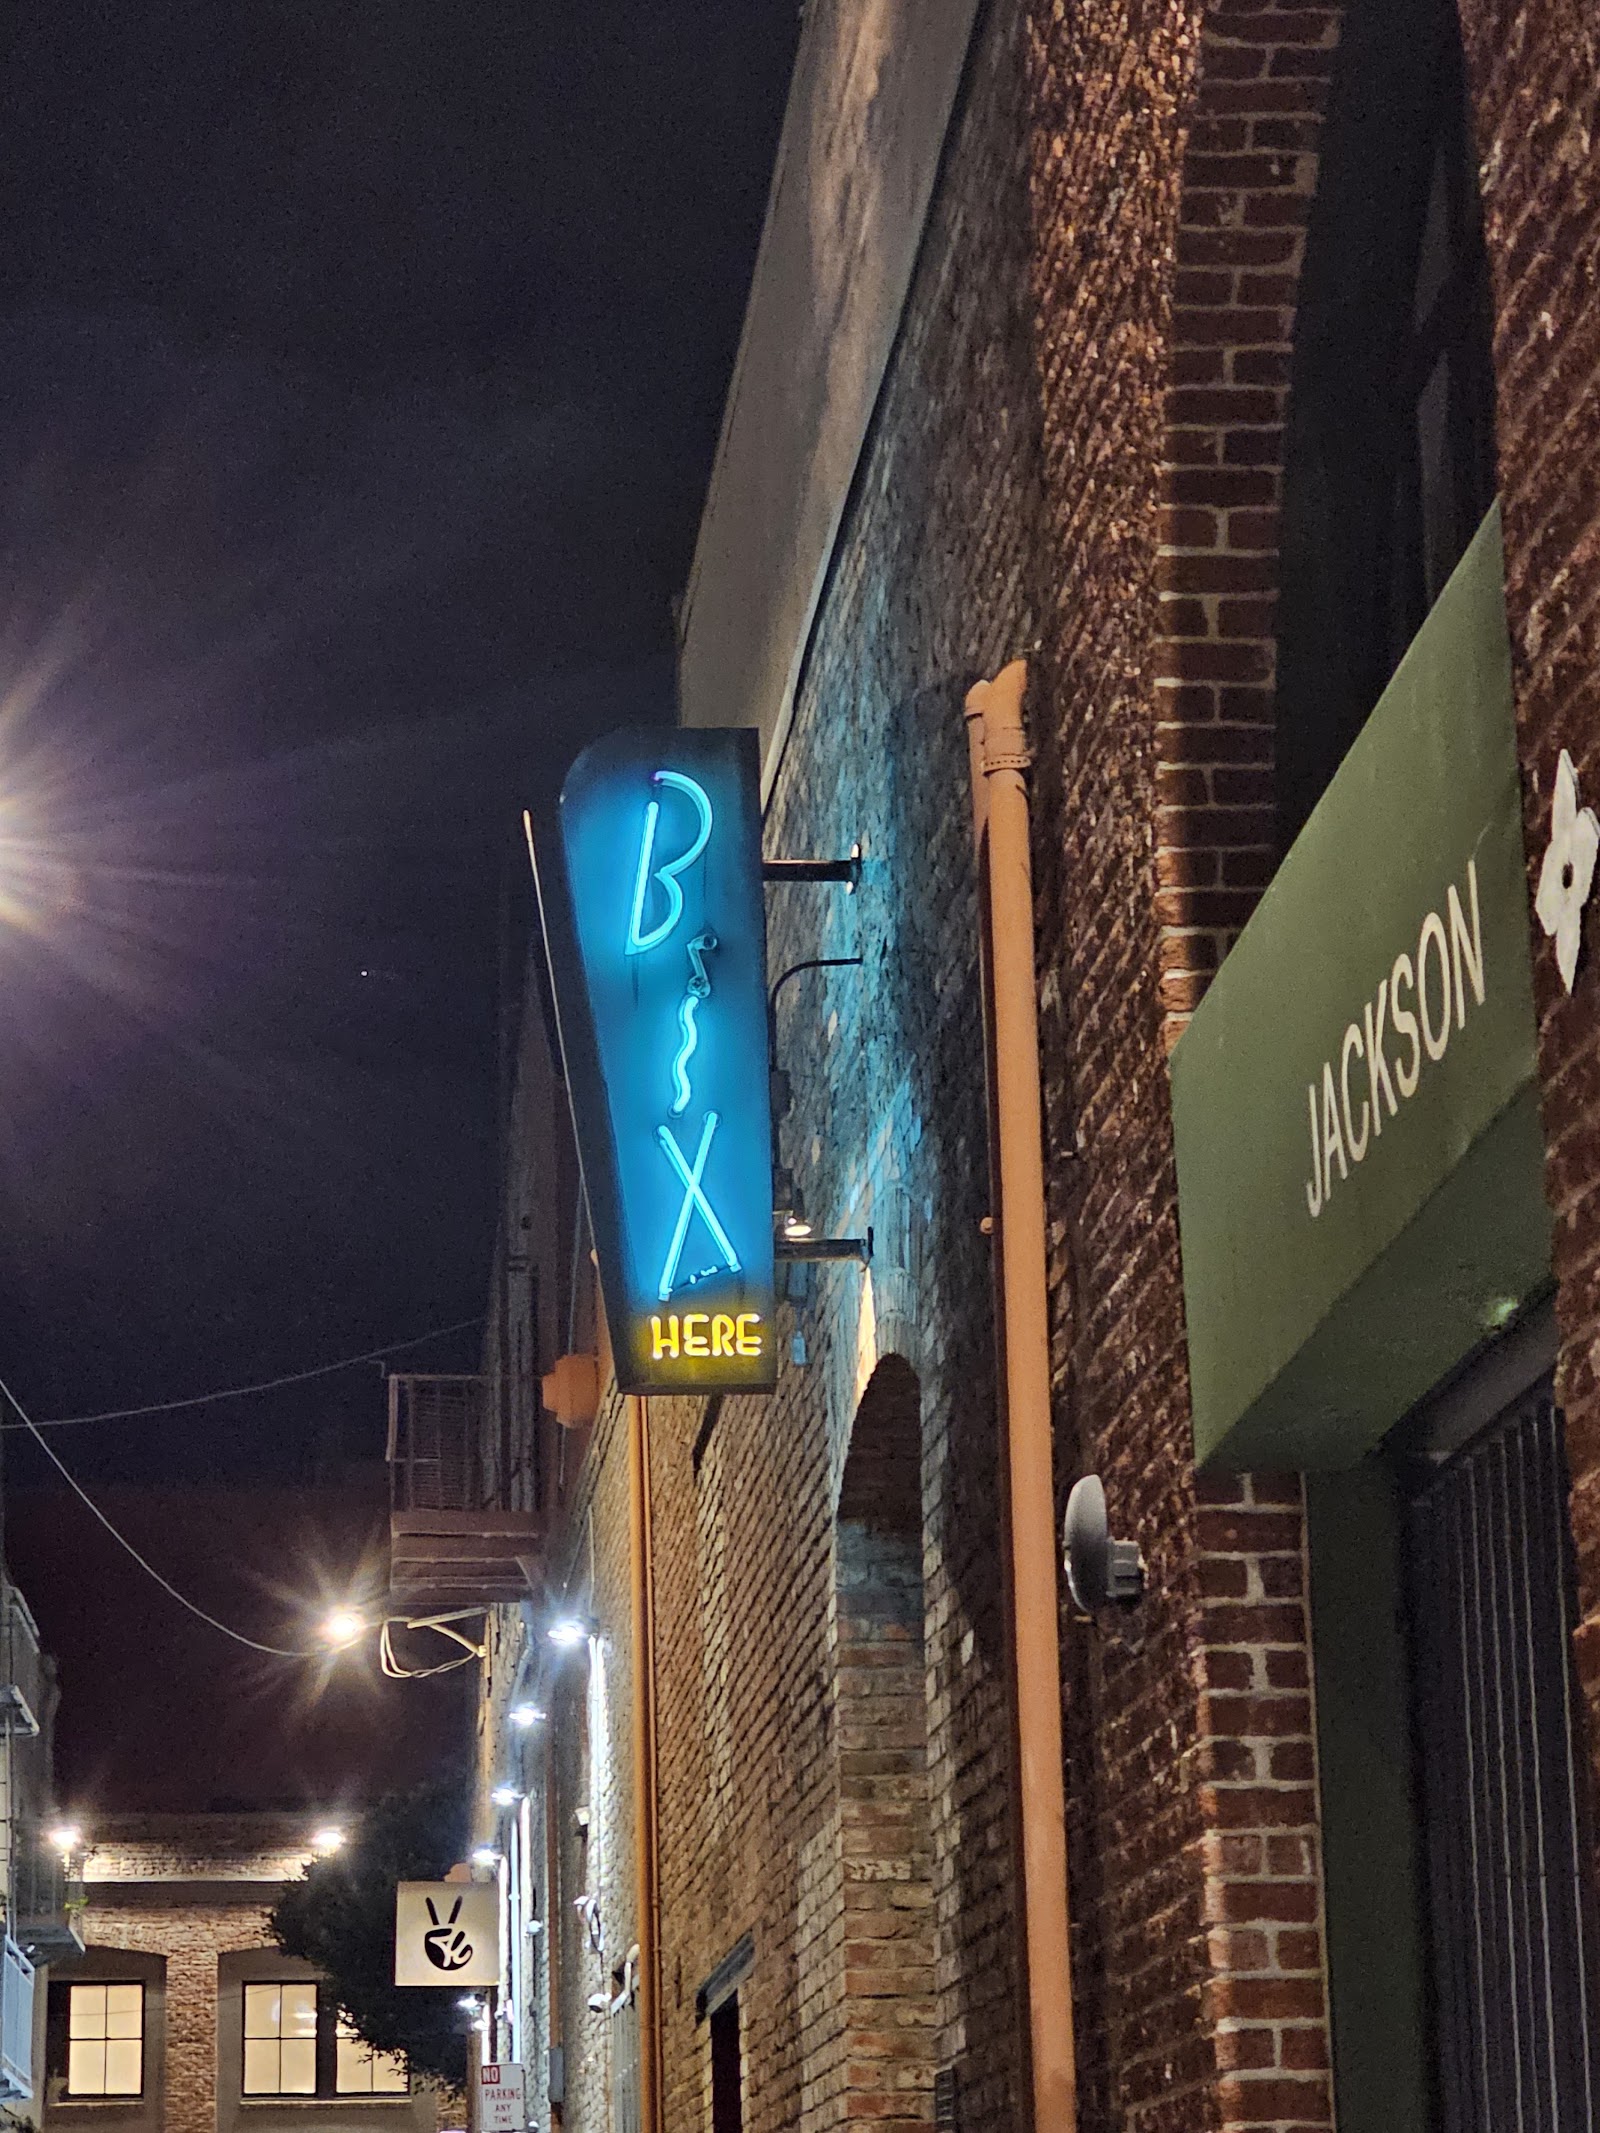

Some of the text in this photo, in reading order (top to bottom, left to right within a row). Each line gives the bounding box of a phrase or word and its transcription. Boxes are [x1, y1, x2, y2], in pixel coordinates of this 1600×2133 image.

[1306, 860, 1486, 1218] JACKSON
[650, 1313, 762, 1360] HERE
[482, 2066, 499, 2083] NO
[485, 2087, 521, 2100] PARKING
[495, 2103, 512, 2112] ANY
[494, 2115, 513, 2124] TIME
